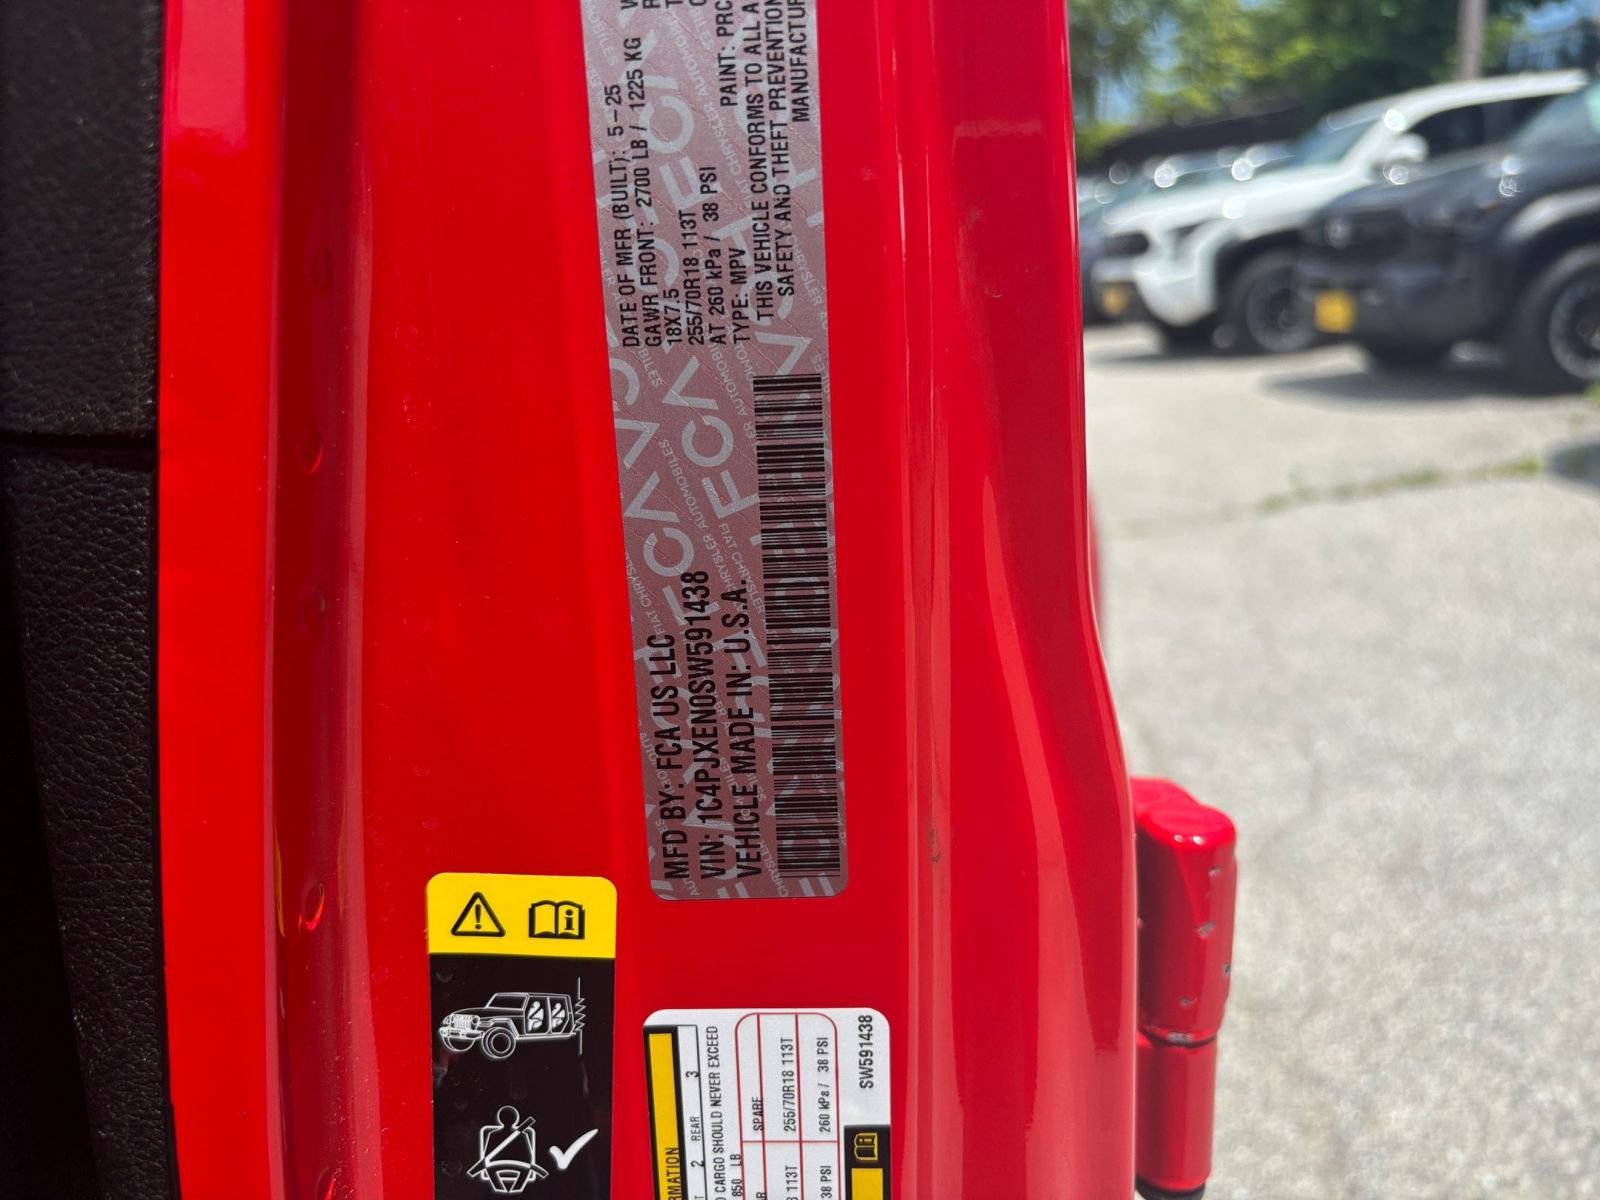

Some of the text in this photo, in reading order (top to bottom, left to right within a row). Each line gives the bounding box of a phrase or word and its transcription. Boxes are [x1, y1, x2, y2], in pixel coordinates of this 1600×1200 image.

[624, 38, 641, 62] KG
[742, 20, 761, 55] ALL
[626, 69, 645, 109] 1225
[718, 46, 737, 107] PAINT:
[744, 63, 762, 87] TO
[630, 139, 647, 159] LB
[745, 94, 767, 194] CONFORMS
[770, 119, 790, 178] THEFT
[609, 150, 633, 220] (BUILT):
[632, 168, 652, 207] 2700
[699, 167, 717, 194] PSI
[701, 202, 718, 221] 38
[772, 184, 791, 221] AND
[614, 228, 632, 266] MFR
[637, 221, 658, 285] FRONT:
[750, 201, 772, 273] VEHICLE
[679, 210, 703, 345] 255/70R18 113T
[704, 249, 722, 279] kPa
[729, 247, 746, 284] MPV
[774, 232, 794, 296] SAFETY
[617, 273, 636, 295] OF
[706, 287, 724, 315] 260
[754, 281, 774, 320] THIS
[619, 302, 640, 347] DATE
[642, 294, 662, 347] GAWR
[662, 289, 682, 346] 18X7.5
[709, 323, 726, 345] AT
[731, 293, 750, 344] TYPE:
[660, 439, 708, 529] AUTOMOBILES
[647, 635, 675, 674] LLC
[650, 685, 679, 716] US
[720, 579, 762, 878] VEHICLE MADE IN: U.S.A.
[654, 726, 682, 769] FCA
[658, 784, 686, 820] BY:
[661, 830, 689, 879] MFD
[697, 833, 726, 879] VIN:
[706, 1025, 720, 1067] EXCEED
[780, 1037, 794, 1065] 113T
[816, 1037, 829, 1055] PSI
[857, 1014, 874, 1089] SW591438
[685, 1070, 700, 1078] 3
[817, 1058, 829, 1072] 38
[708, 1072, 722, 1107] NEVER
[782, 1070, 796, 1132] 255/70R18
[817, 1090, 831, 1109] kPa
[690, 1116, 701, 1141] REAR
[711, 1111, 724, 1153] SHOULD
[751, 1097, 764, 1131] SPARE
[818, 1112, 831, 1133] 260
[713, 1157, 726, 1192] CARGO
[730, 1153, 742, 1197] 850 LB
[785, 1165, 798, 1191] 113T
[820, 1165, 831, 1182] PSI
[820, 1186, 832, 1199] 38
